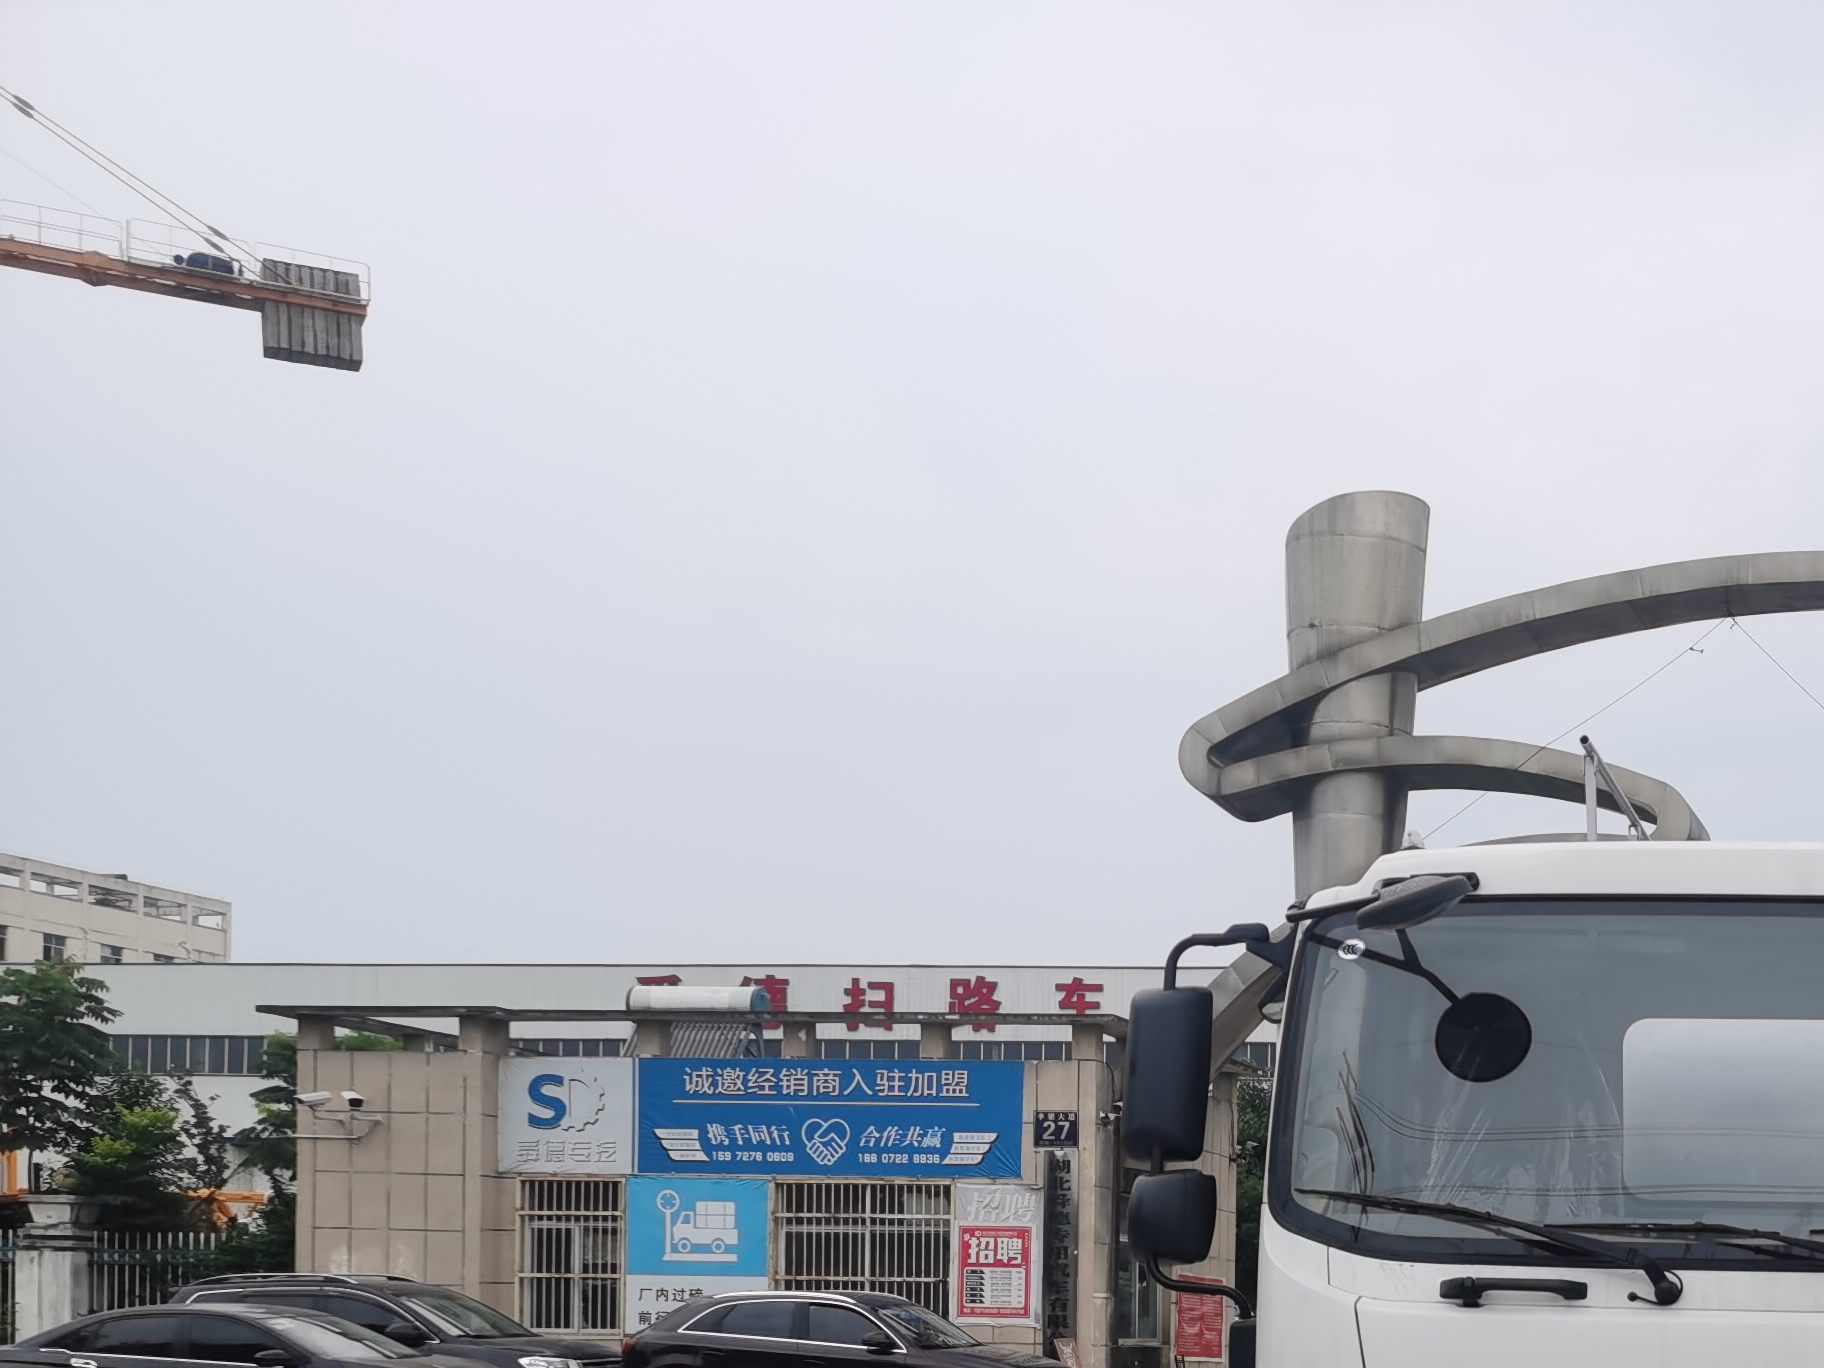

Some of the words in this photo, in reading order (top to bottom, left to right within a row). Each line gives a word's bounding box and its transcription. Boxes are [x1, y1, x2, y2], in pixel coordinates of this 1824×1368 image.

[683, 1066, 970, 1099] 诚邀经销商入驻加盟
[706, 1123, 792, 1146] 携手同行
[858, 1125, 947, 1148] 合作共赢
[1042, 1120, 1070, 1140] 27
[712, 1151, 732, 1162] 159
[735, 1151, 763, 1162] 7276
[881, 1153, 910, 1165] 0722
[968, 1191, 1036, 1222] 招聘
[967, 1237, 1023, 1265] 招聘
